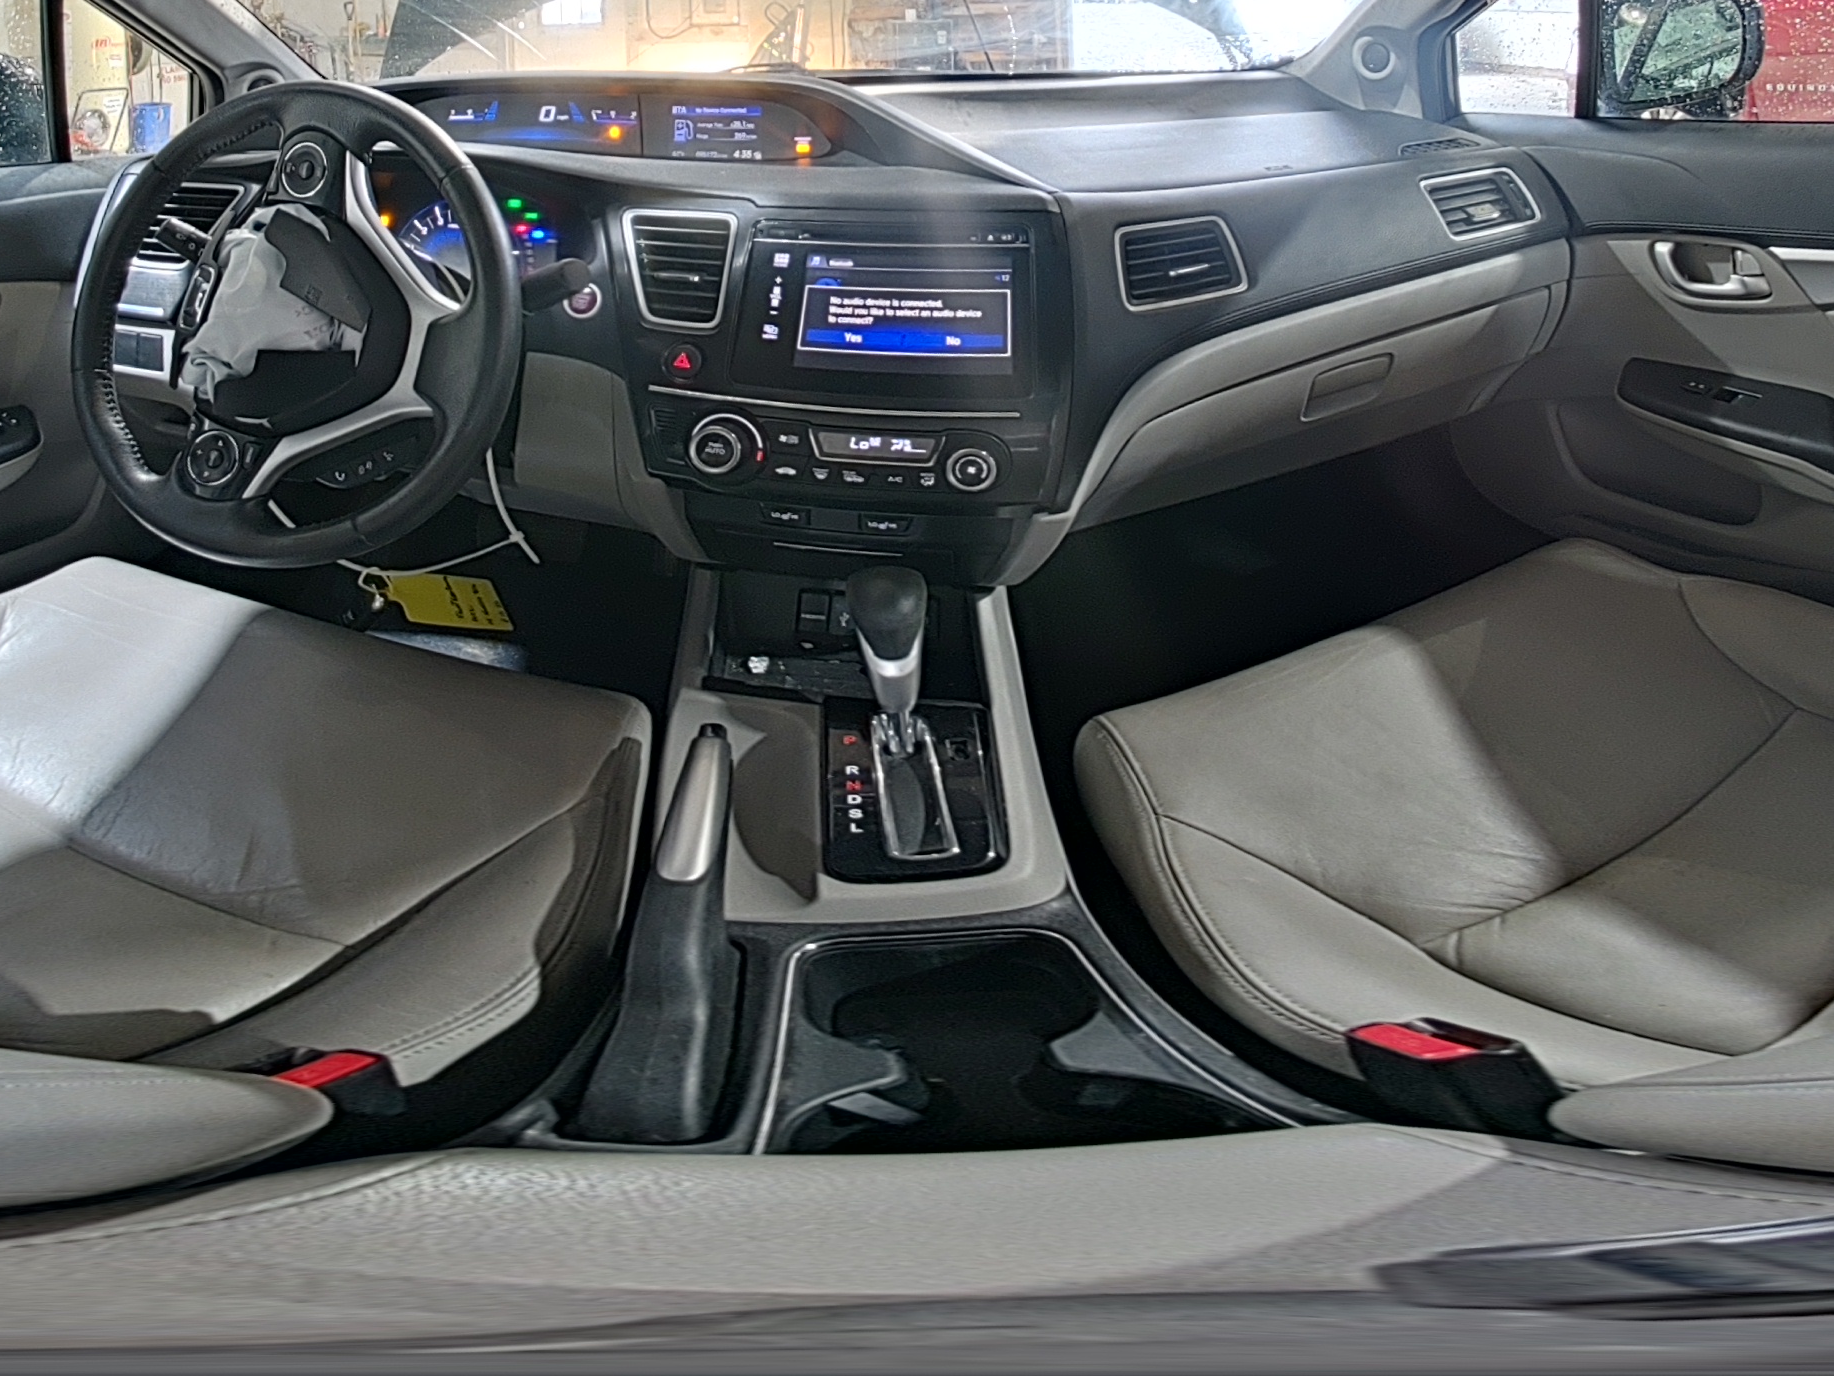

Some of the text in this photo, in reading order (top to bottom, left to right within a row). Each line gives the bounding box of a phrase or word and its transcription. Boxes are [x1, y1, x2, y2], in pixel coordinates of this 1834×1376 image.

[539, 105, 557, 122] 0
[829, 295, 842, 305] No
[842, 297, 864, 306] audio
[865, 298, 891, 307] device
[828, 305, 853, 315] Would
[854, 307, 869, 316] you
[869, 306, 885, 316] like
[895, 308, 919, 317] select
[920, 310, 931, 318] an
[932, 309, 954, 318] audio
[955, 309, 983, 318] device
[837, 316, 874, 325] connect?
[844, 332, 863, 343] Yes
[946, 335, 962, 346] No
[705, 447, 726, 455] AUTO
[843, 735, 857, 745] P
[845, 765, 860, 776] R
[846, 780, 862, 792] N
[847, 794, 863, 805] D
[848, 808, 864, 819] S
[850, 822, 864, 833] L
